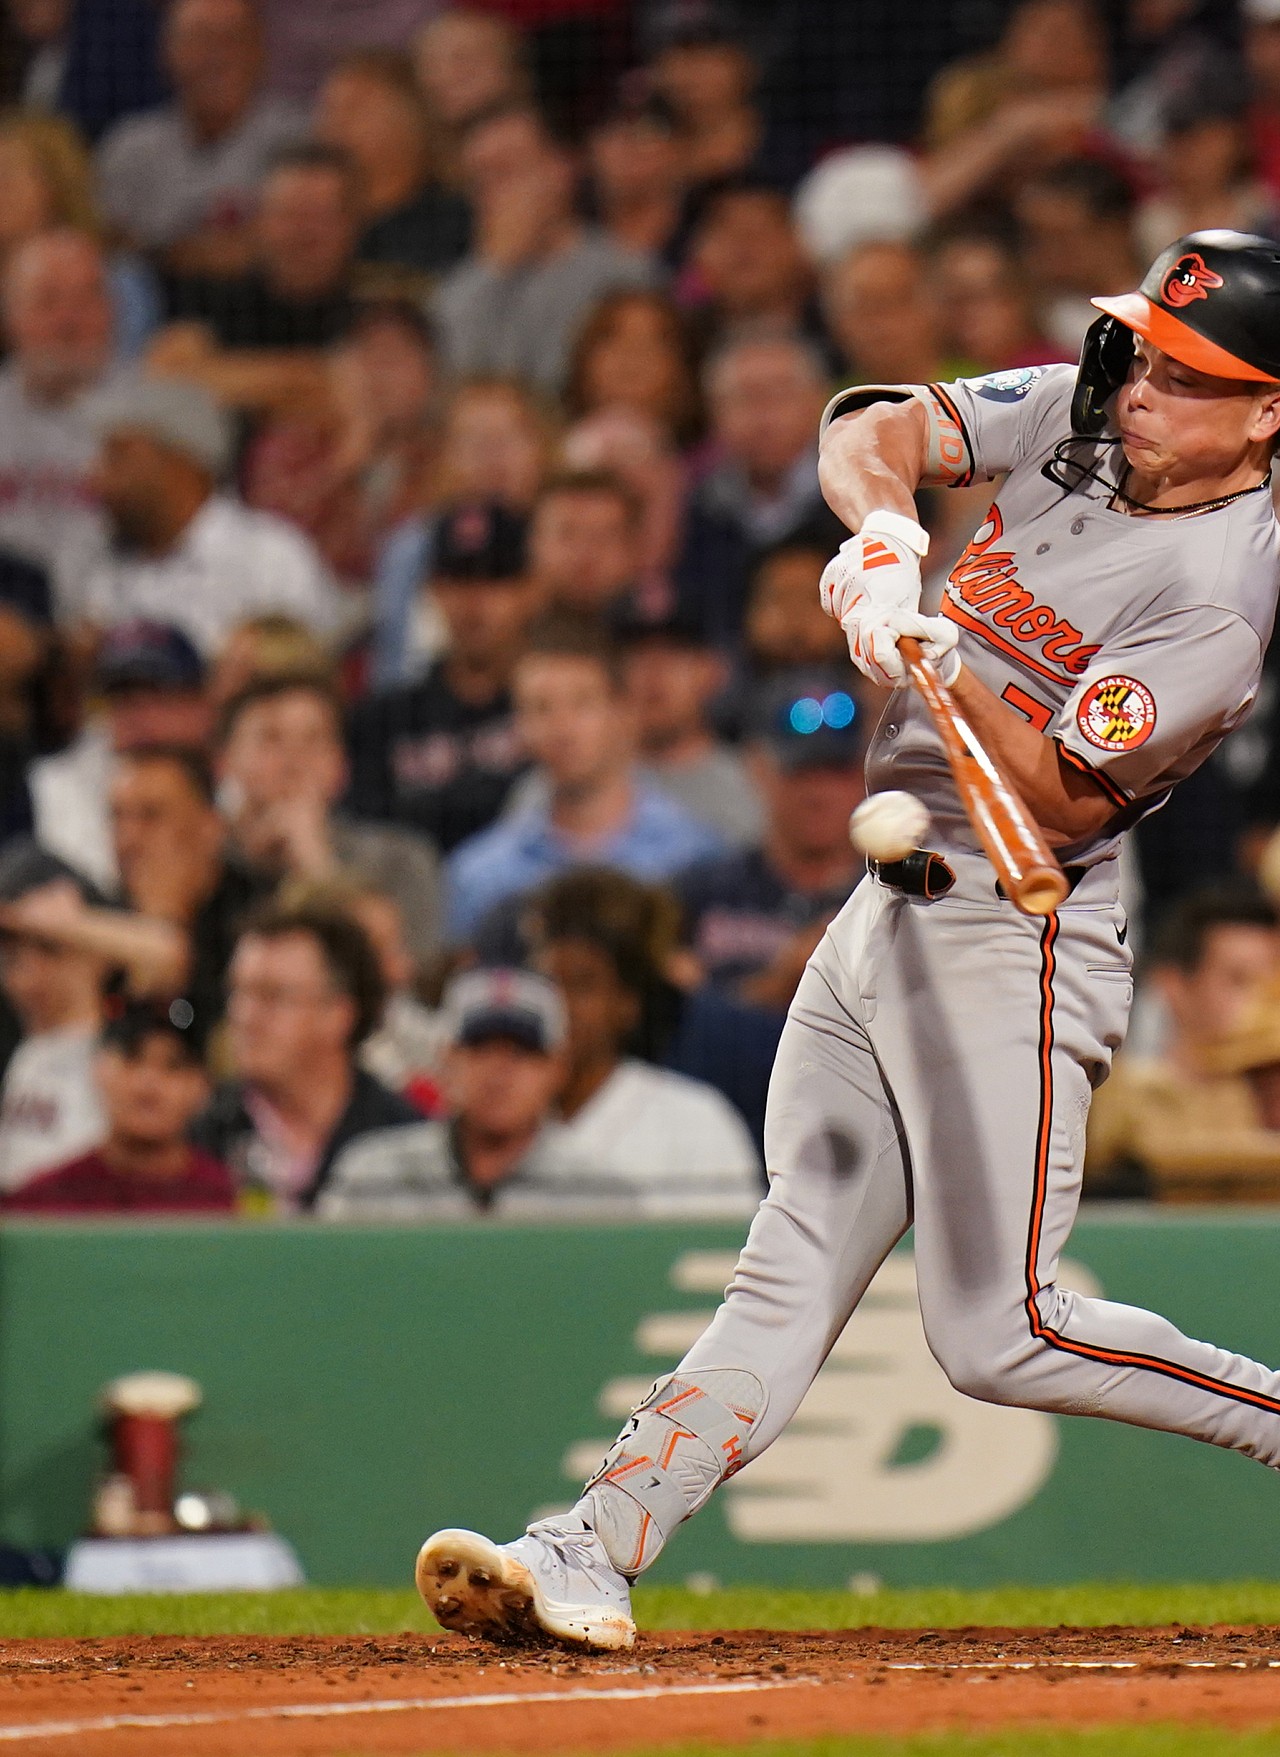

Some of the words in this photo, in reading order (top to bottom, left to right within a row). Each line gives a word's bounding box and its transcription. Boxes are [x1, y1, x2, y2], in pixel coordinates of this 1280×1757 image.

[948, 501, 1104, 674] ltimore
[1097, 678, 1155, 723] BALTIMORE
[1080, 717, 1125, 749] ORIOLES
